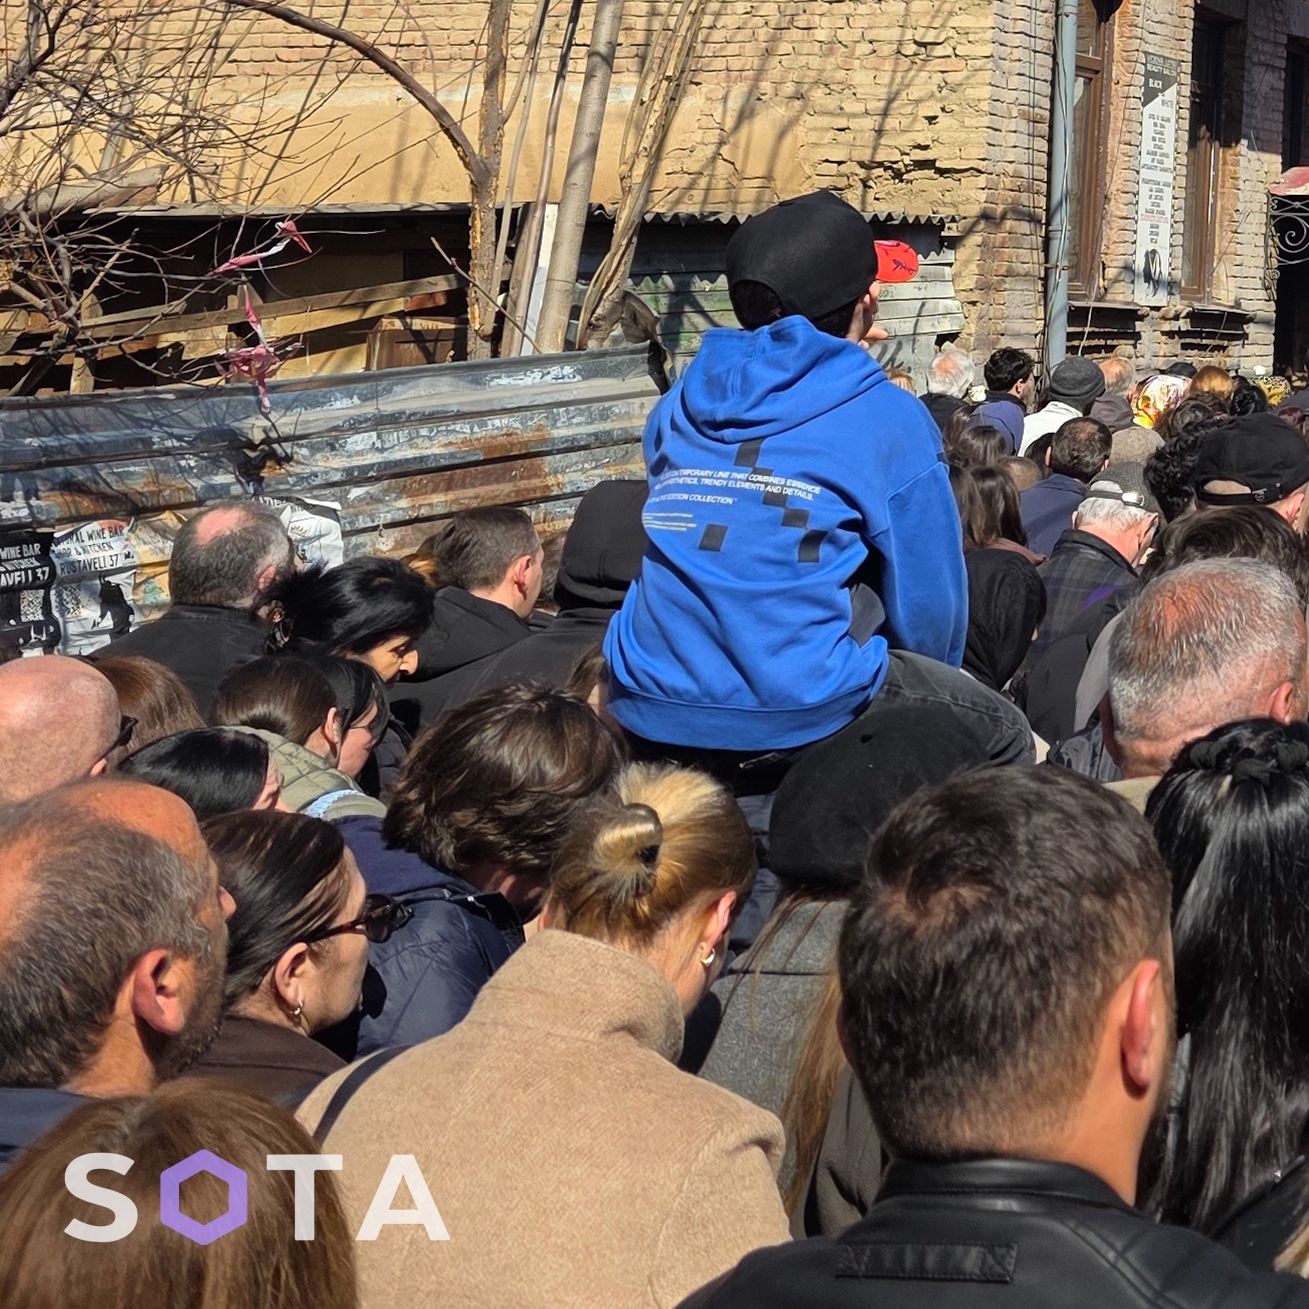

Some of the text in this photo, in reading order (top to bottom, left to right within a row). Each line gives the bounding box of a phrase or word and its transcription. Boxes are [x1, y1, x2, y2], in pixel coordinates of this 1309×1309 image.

[765, 484, 782, 494] AND
[86, 527, 107, 541] WINE
[108, 525, 125, 538] BAR
[0, 543, 41, 560] WINE BAR
[59, 553, 119, 576] RUSTAVELI 37
[35, 566, 50, 581] 37
